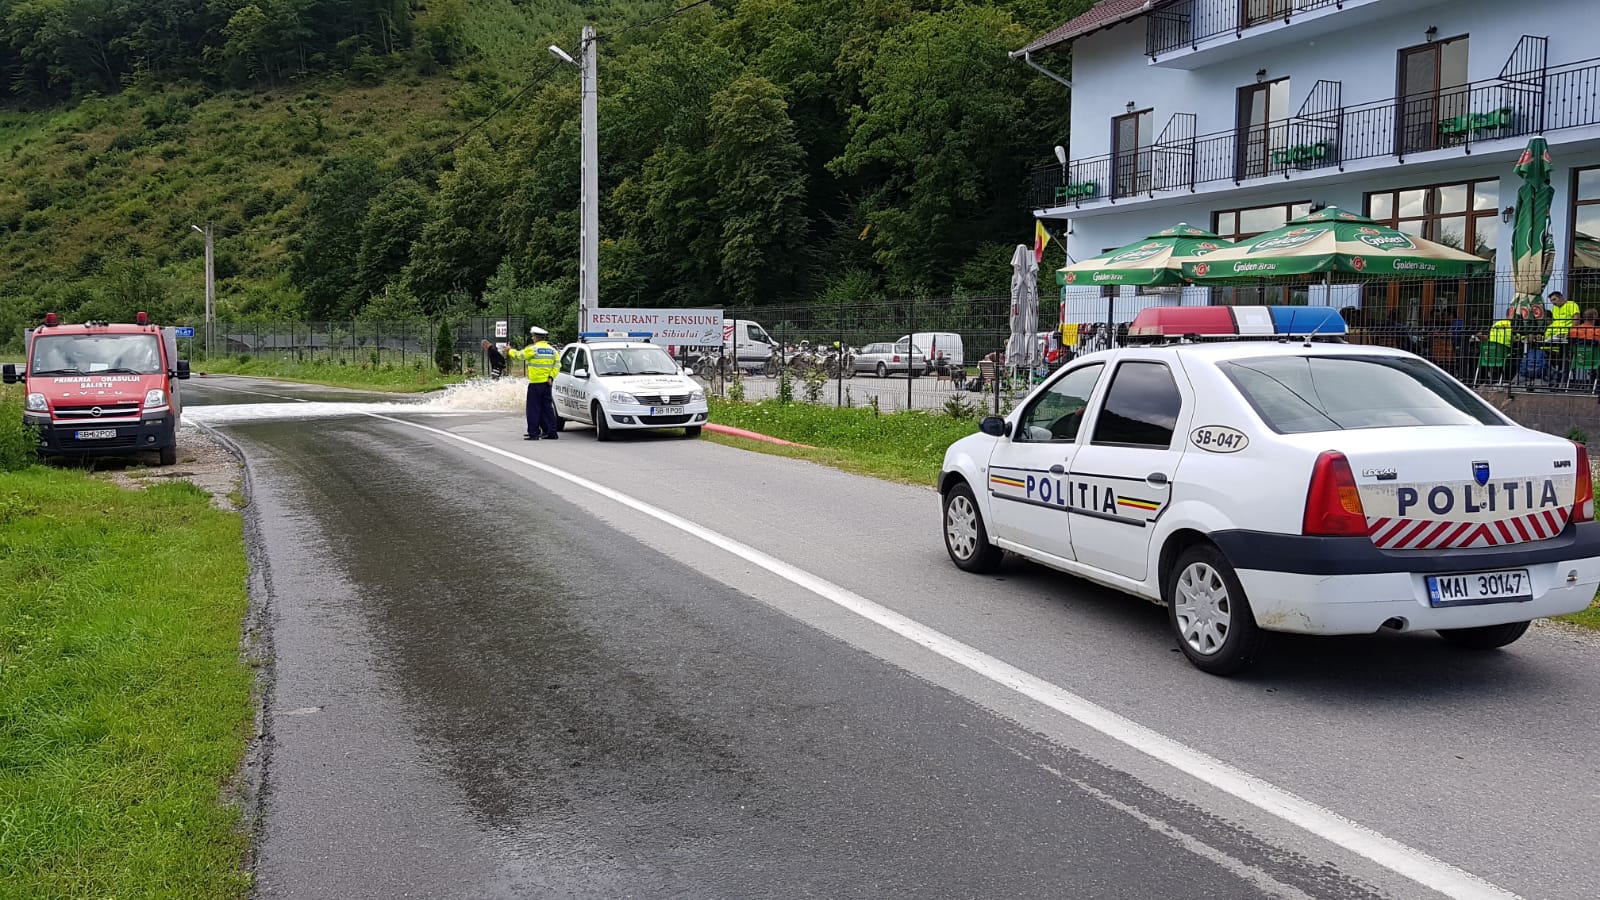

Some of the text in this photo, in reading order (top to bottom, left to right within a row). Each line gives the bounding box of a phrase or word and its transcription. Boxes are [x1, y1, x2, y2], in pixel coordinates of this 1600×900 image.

[1233, 261, 1256, 272] Golden
[1393, 259, 1418, 270] Golden
[1092, 272, 1110, 282] Golden
[592, 314, 659, 322] RESTAURANT
[668, 315, 719, 325] PENSIUNE
[663, 330, 699, 338] Sibiului
[1195, 430, 1242, 448] SB-047
[1027, 475, 1117, 514] POLITIA
[1398, 479, 1558, 516] POLITIA
[1440, 578, 1468, 598] MAI
[1478, 574, 1521, 595] 30147
